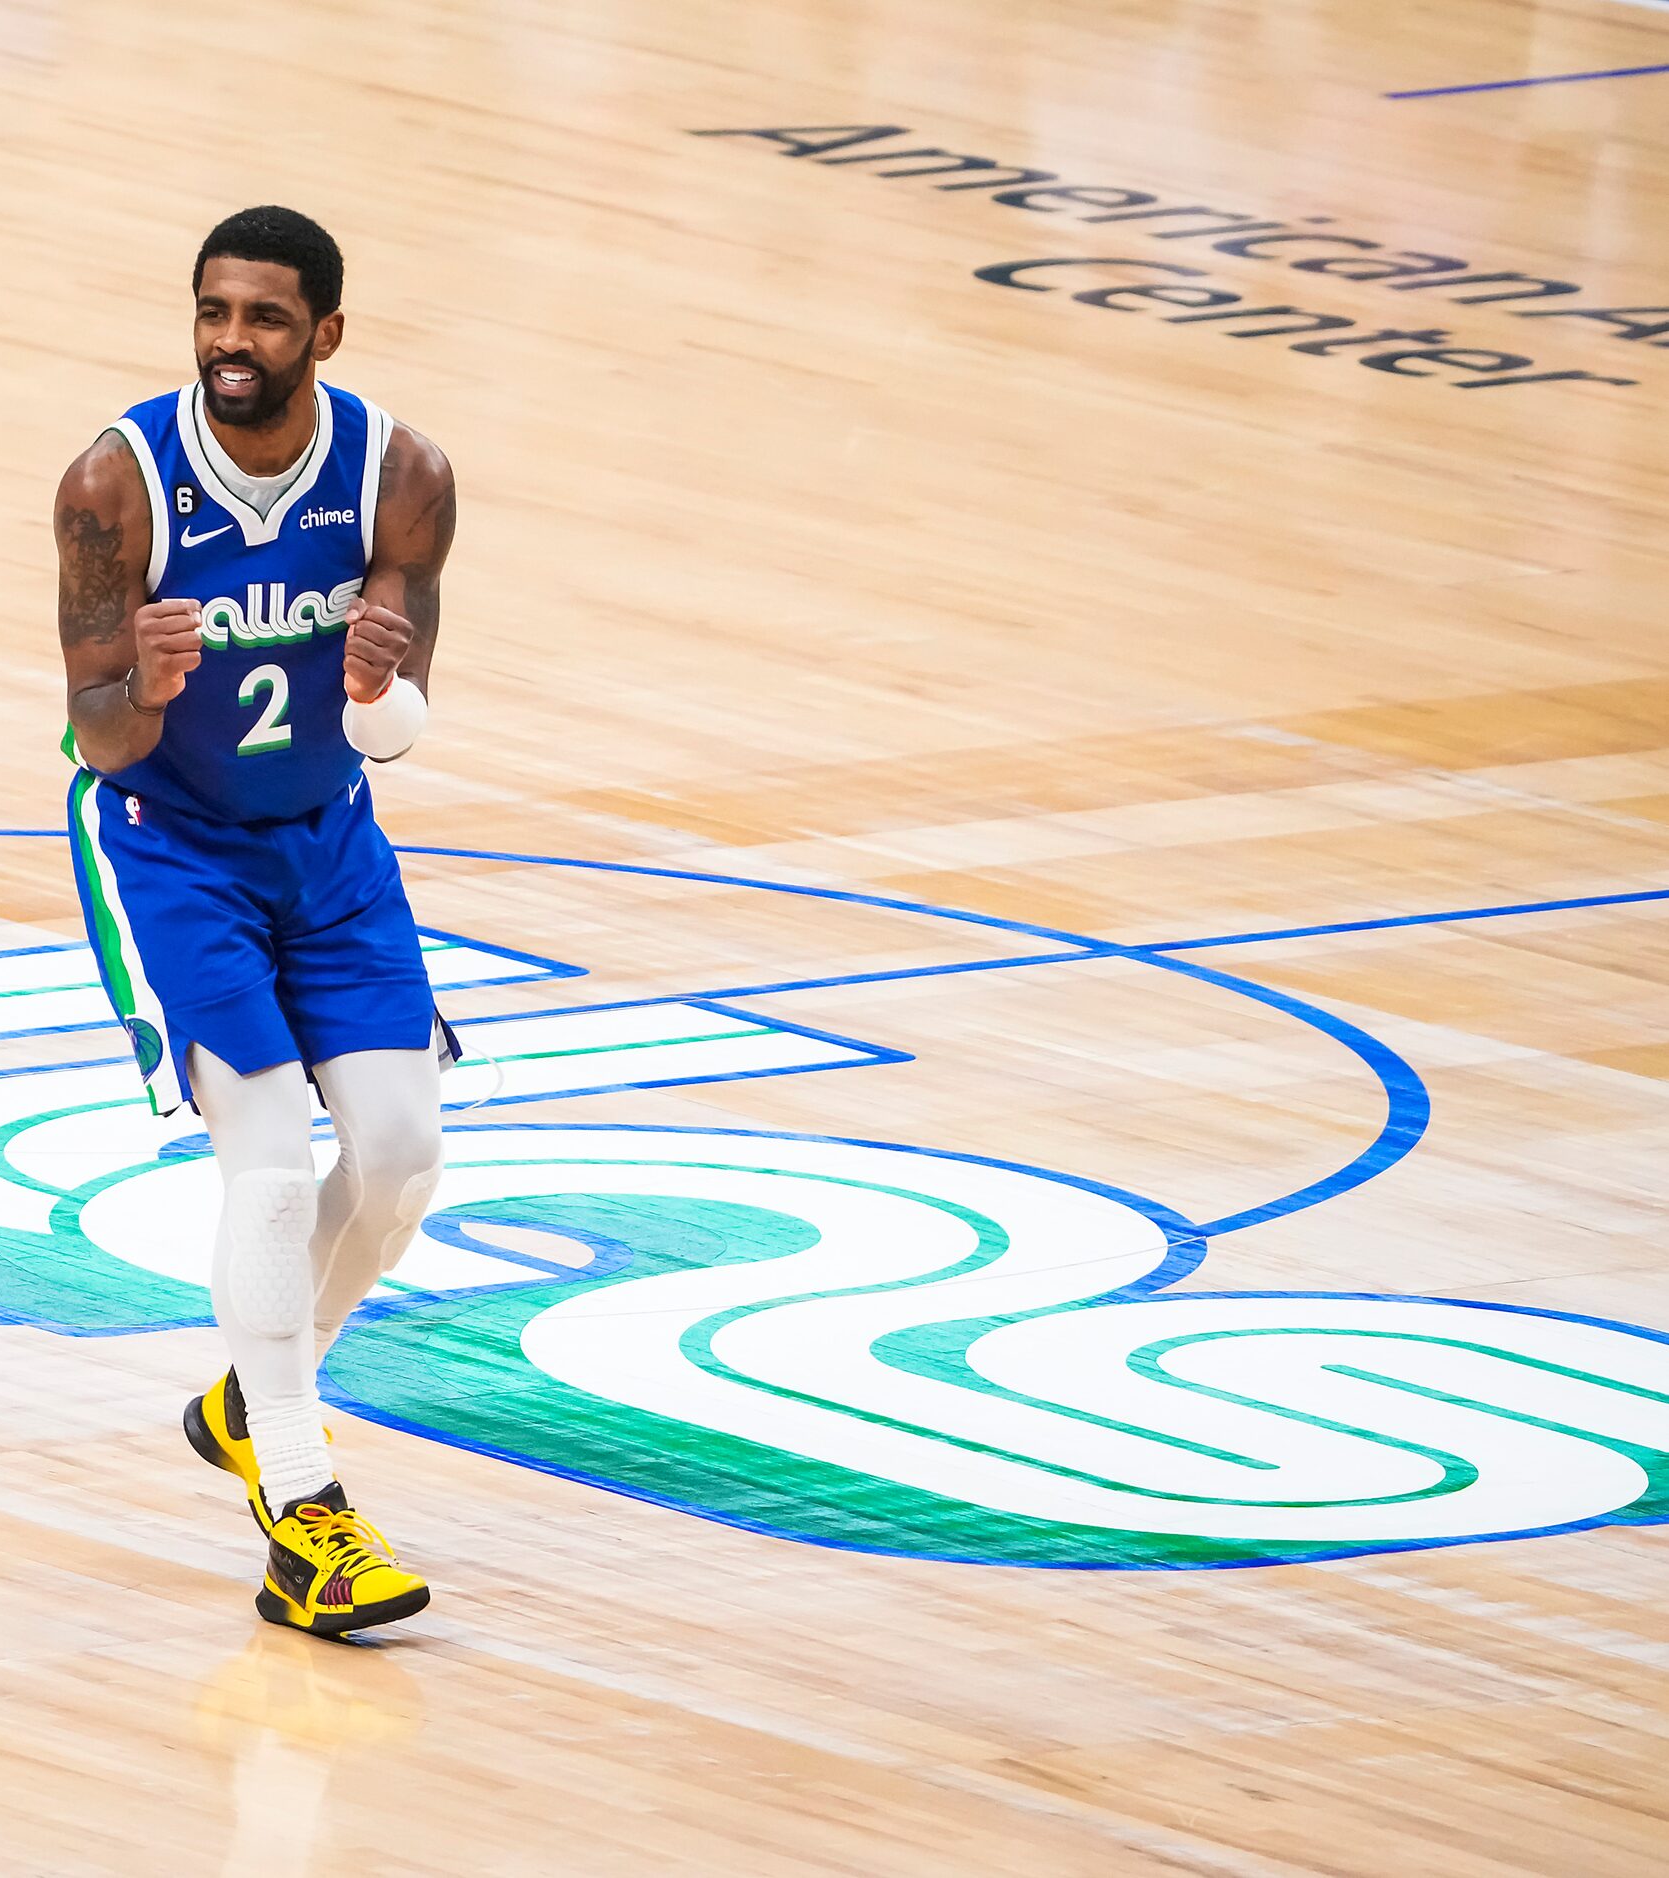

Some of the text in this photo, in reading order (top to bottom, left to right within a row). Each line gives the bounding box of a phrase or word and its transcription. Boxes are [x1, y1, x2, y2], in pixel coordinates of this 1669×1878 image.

[973, 257, 1641, 388] Center
[176, 486, 193, 514] 6
[299, 506, 355, 530] chime
[162, 577, 364, 651] allas
[236, 664, 292, 757] 2
